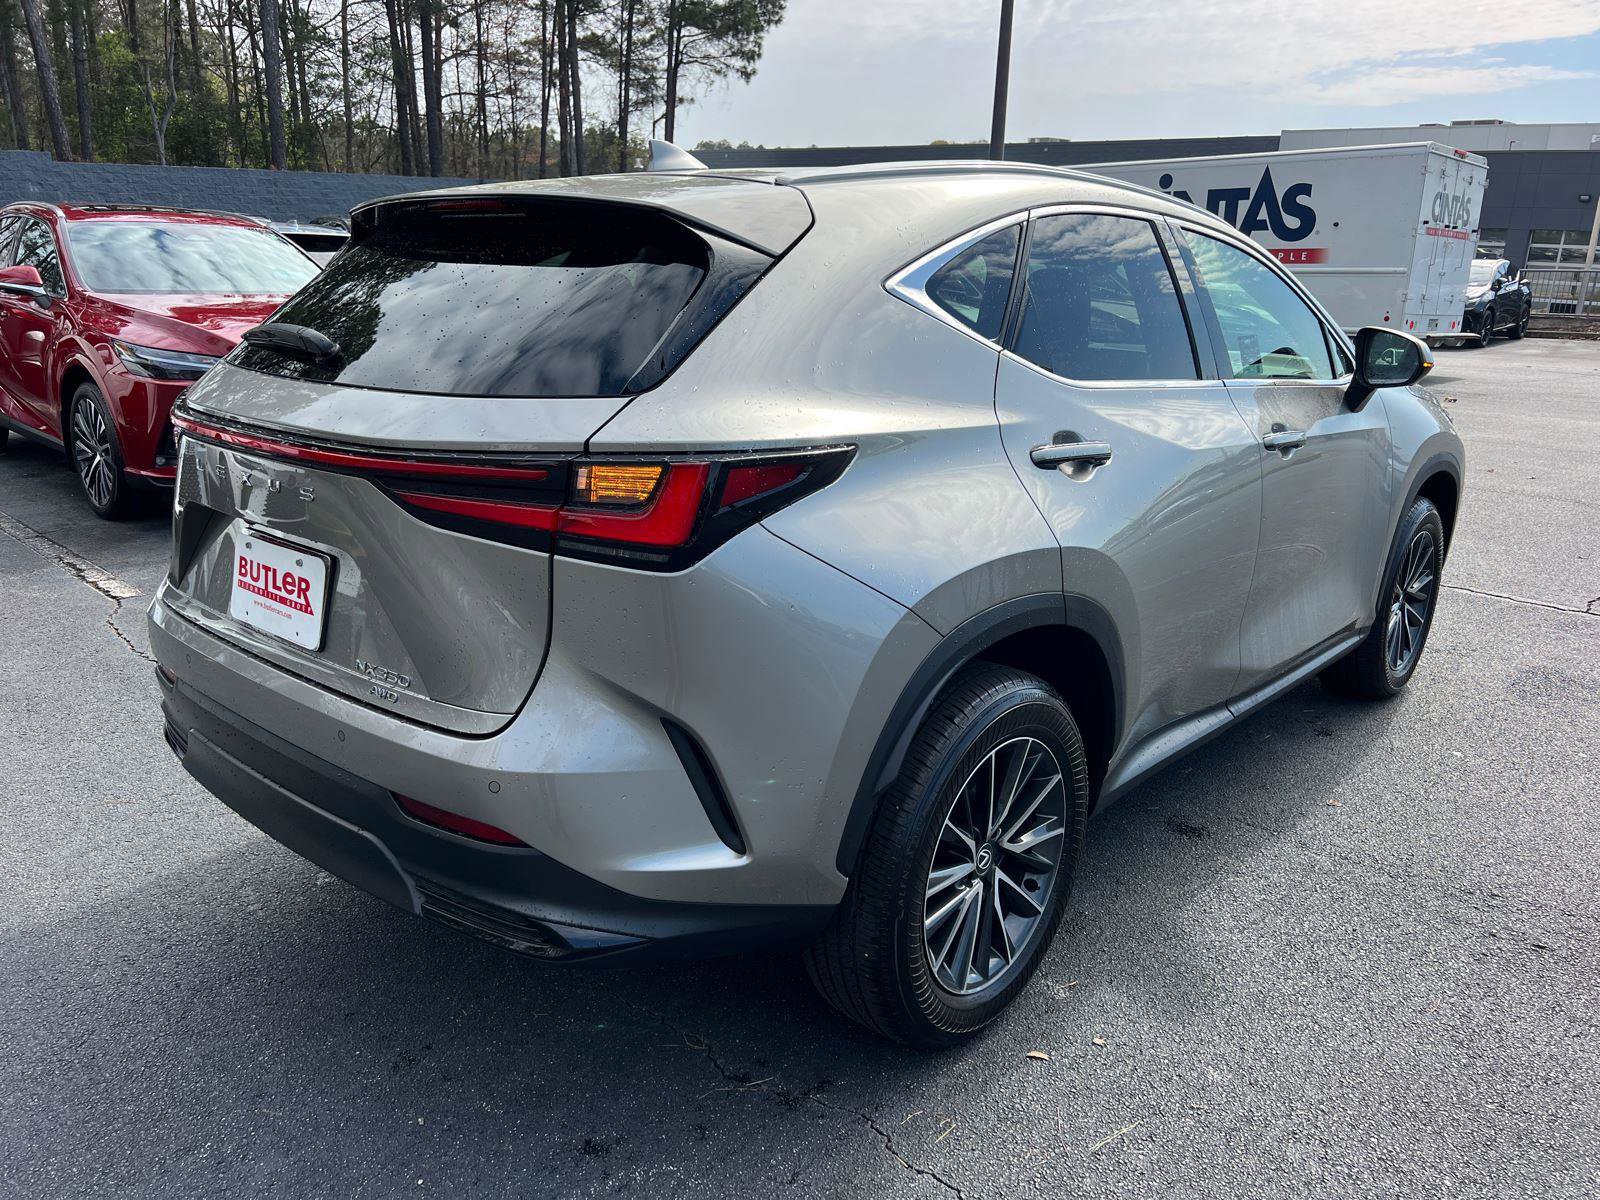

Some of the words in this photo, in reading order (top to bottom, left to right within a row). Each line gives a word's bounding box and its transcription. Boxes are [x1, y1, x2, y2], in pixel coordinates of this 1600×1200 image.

[195, 457, 316, 502] LEXUS
[355, 658, 411, 688] NX350
[368, 686, 398, 703] AWD
